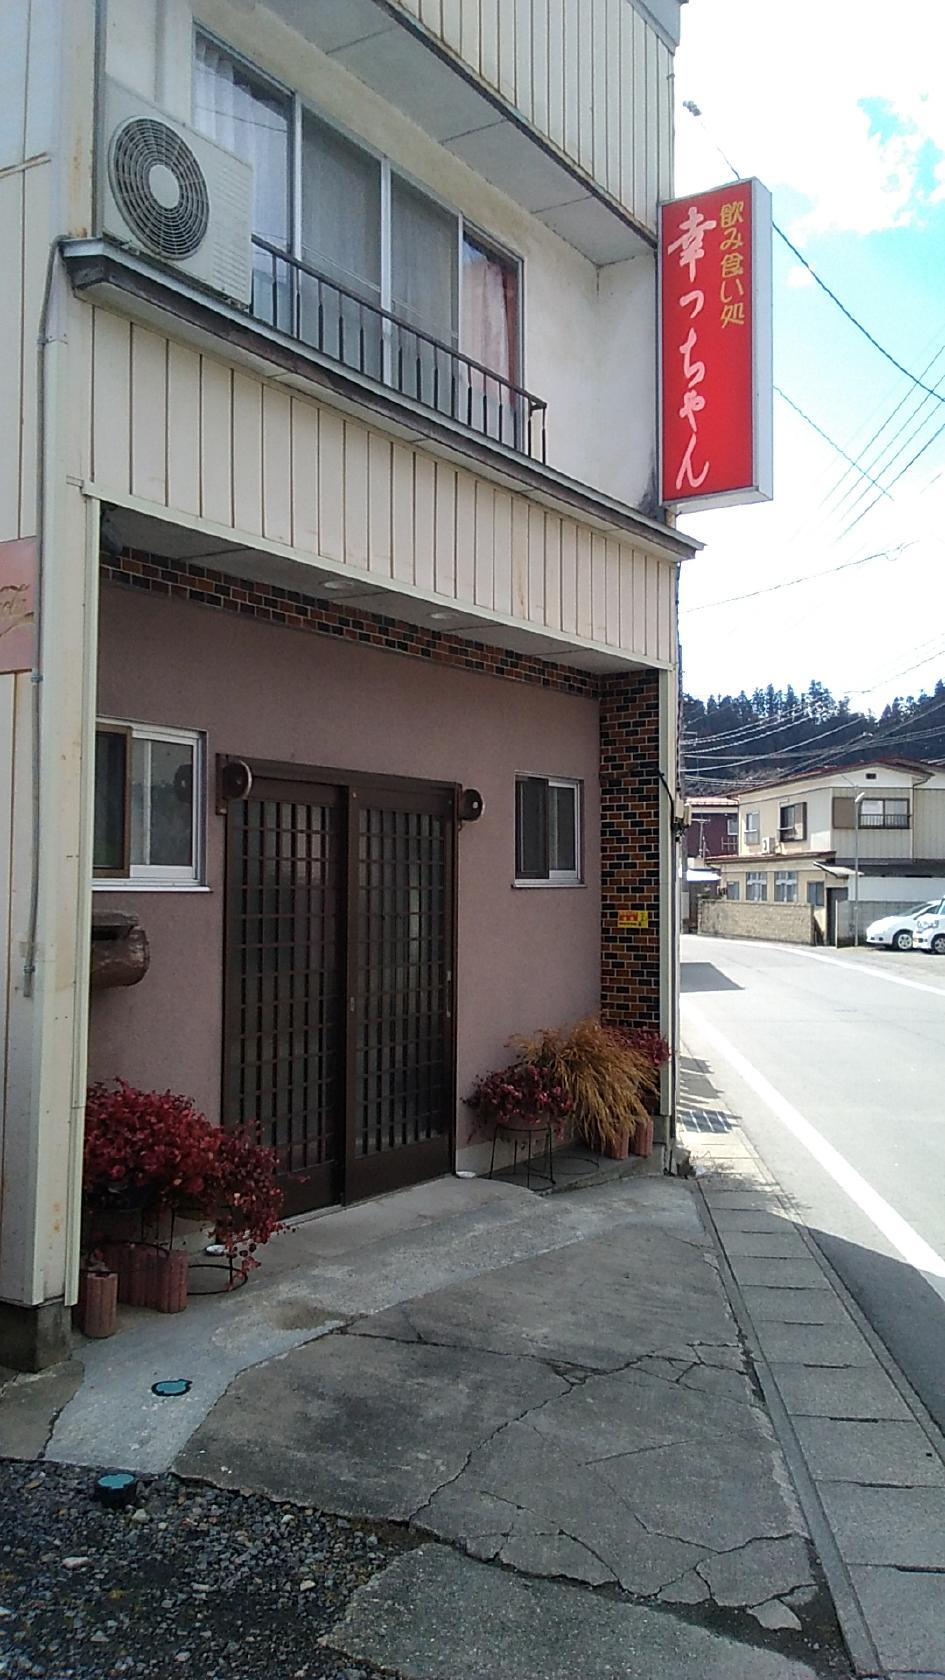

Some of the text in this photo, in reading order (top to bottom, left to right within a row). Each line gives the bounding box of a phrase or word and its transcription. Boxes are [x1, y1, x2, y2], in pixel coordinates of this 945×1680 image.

[720, 201, 745, 328] 飲み食い処
